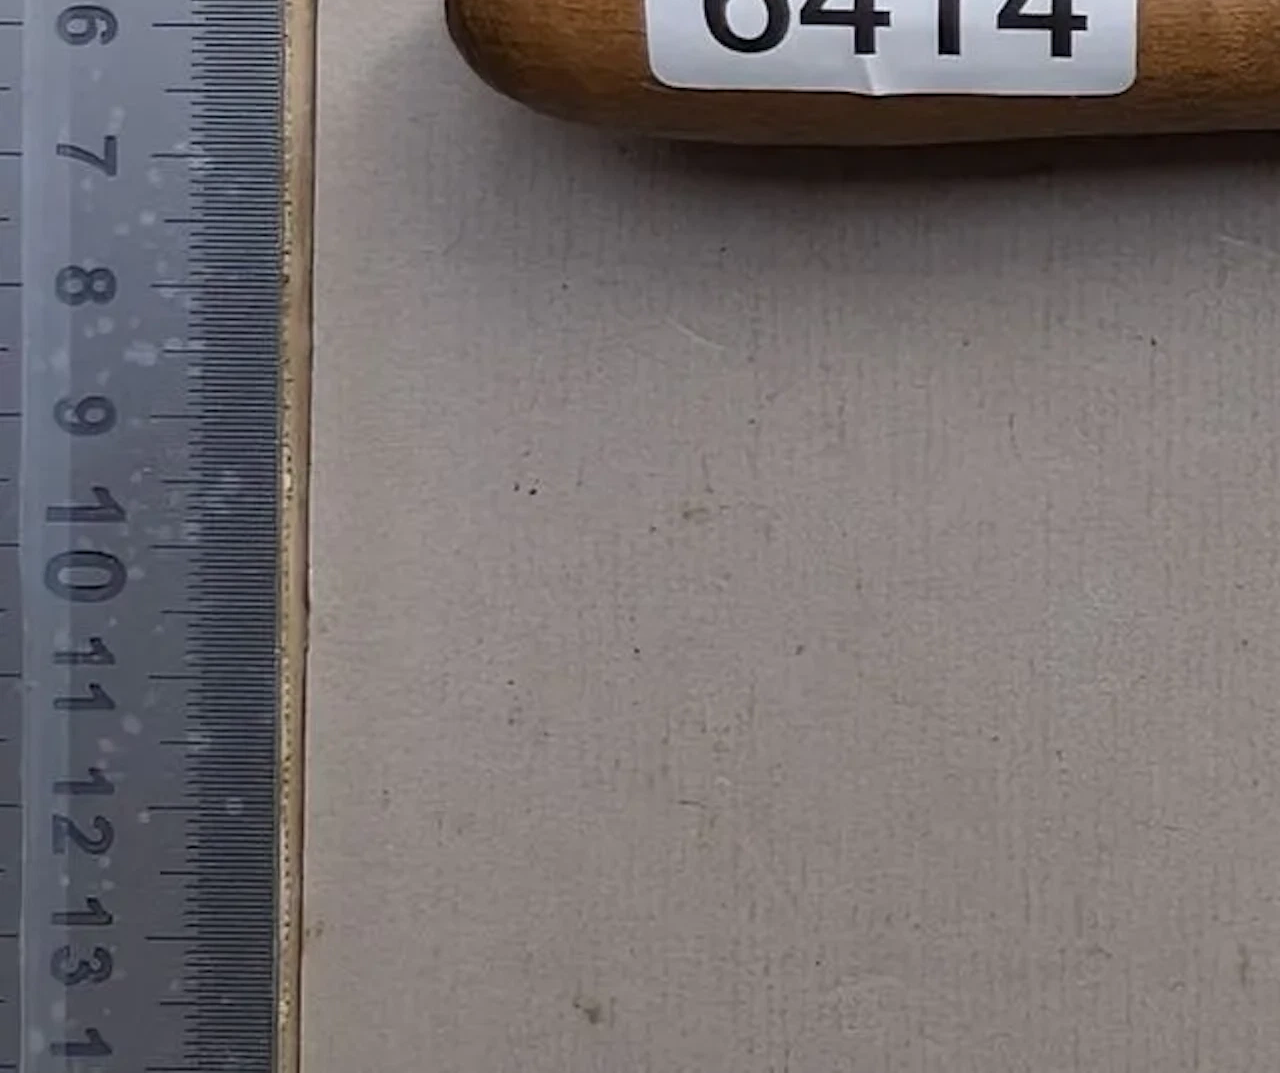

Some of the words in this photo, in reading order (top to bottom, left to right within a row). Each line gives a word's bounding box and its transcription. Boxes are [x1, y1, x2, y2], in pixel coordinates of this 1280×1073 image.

[56, 5, 119, 46] 6
[56, 135, 118, 177] 7
[56, 265, 117, 306] 8
[55, 396, 117, 436] 9
[45, 486, 127, 603] 10
[54, 637, 116, 711] 11
[53, 767, 114, 855] 12
[52, 898, 113, 986] 13
